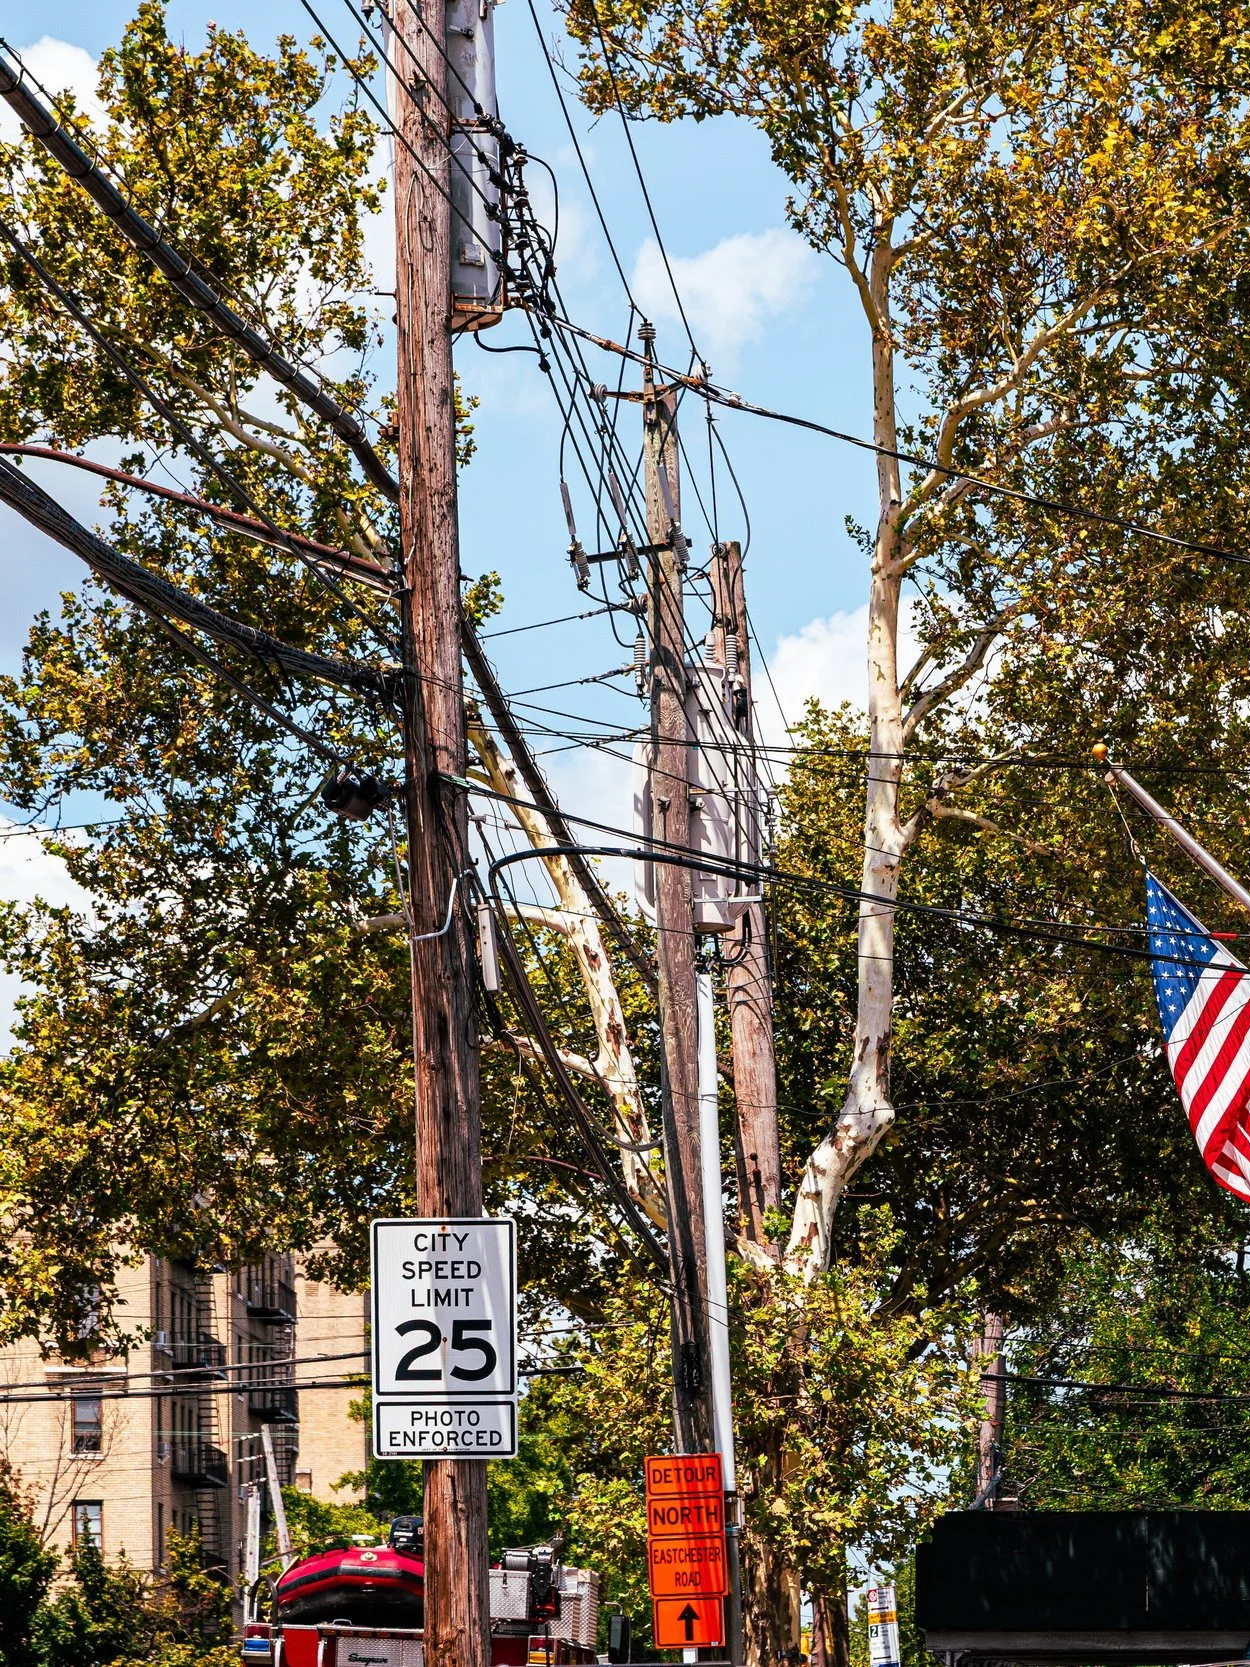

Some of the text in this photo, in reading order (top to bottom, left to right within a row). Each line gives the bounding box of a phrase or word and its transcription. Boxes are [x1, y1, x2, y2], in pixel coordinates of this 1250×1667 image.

[414, 1233, 470, 1252] CITY
[402, 1261, 482, 1280] SPEED
[411, 1288, 474, 1307] LIMIT
[394, 1319, 497, 1381] 25
[411, 1411, 480, 1426] PHOTO
[389, 1431, 502, 1447] ENFORCED
[652, 1467, 716, 1484] DETOUR
[653, 1505, 718, 1526] NORTH
[653, 1547, 721, 1565] EASTCHESTER
[675, 1572, 701, 1587] ROAD
